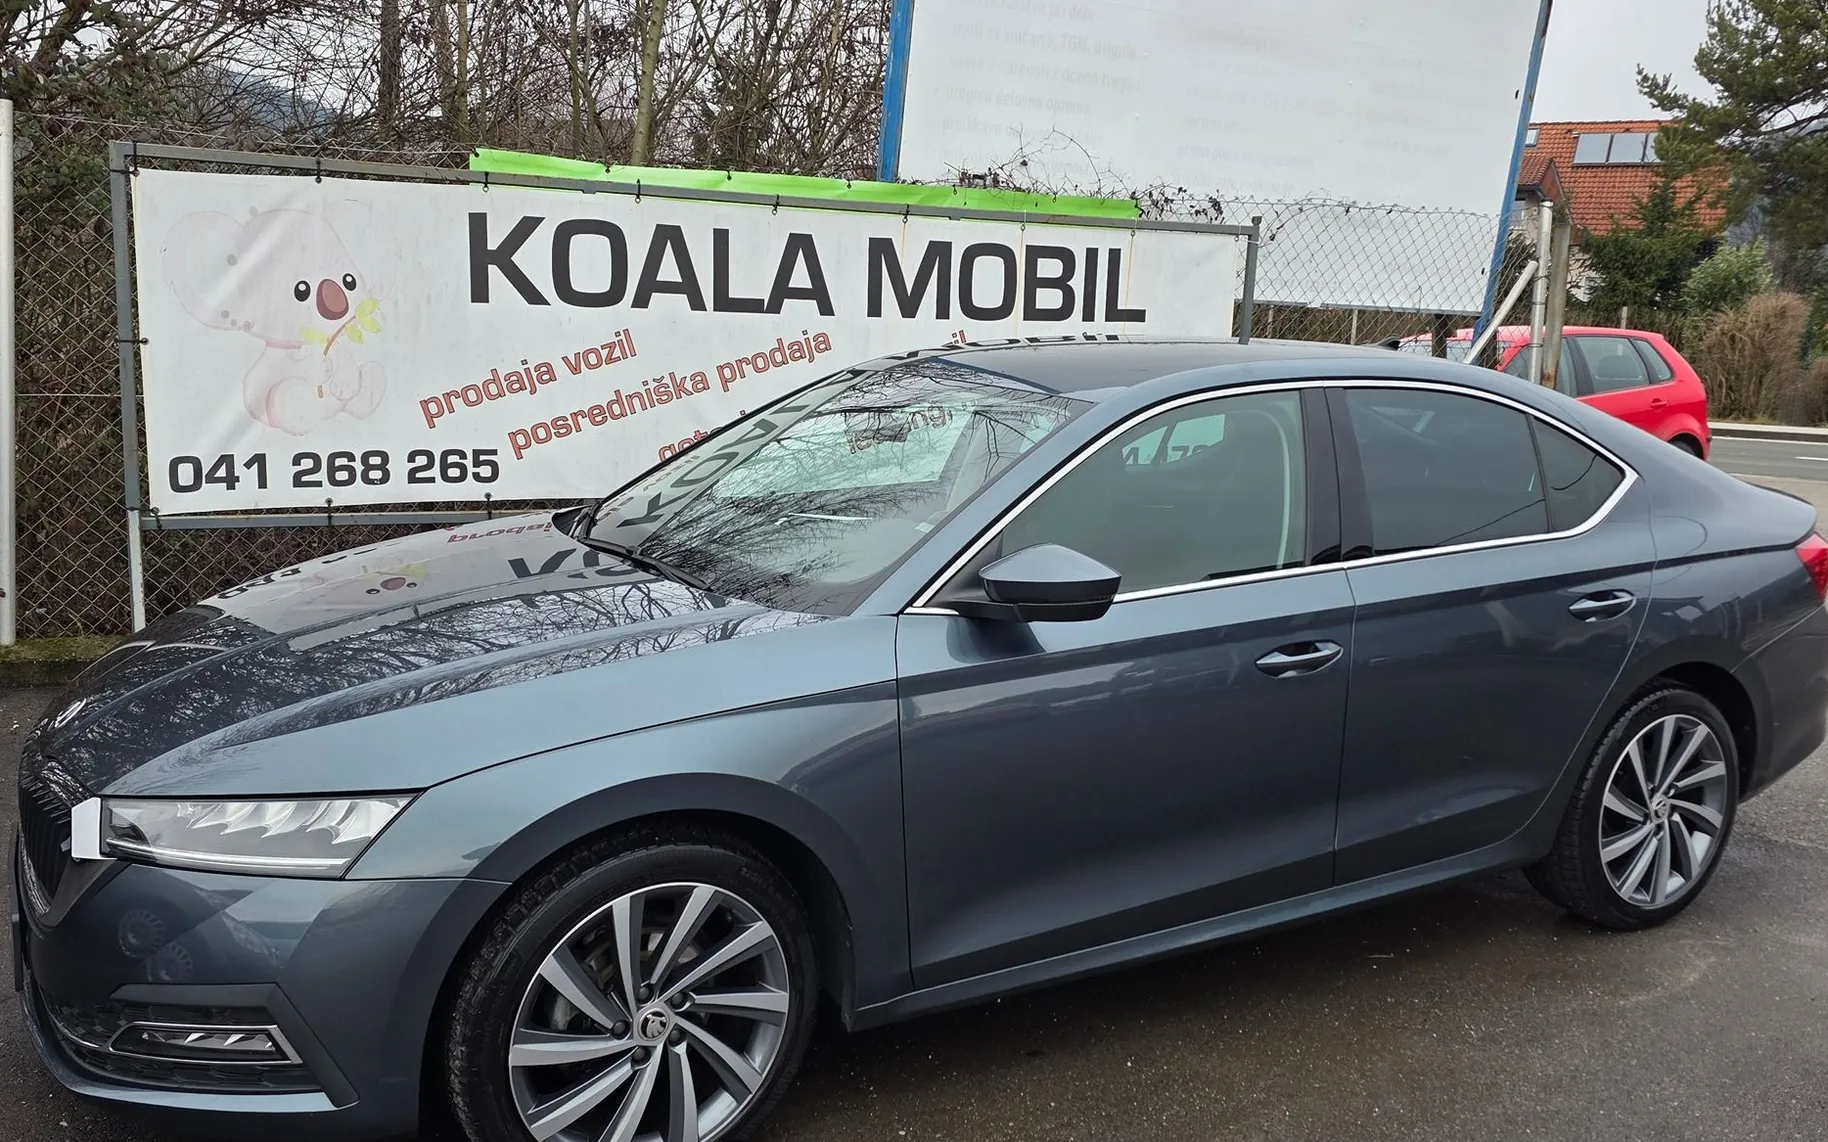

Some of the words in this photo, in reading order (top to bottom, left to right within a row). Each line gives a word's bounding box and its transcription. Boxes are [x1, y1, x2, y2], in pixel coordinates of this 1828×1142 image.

[469, 213, 835, 316] KOALA
[867, 238, 1146, 322] MOBIL
[419, 359, 557, 429] prodaja
[561, 328, 637, 376] vozil
[507, 372, 710, 460] posredniška
[716, 330, 832, 392] prodaja
[169, 453, 267, 493] 041
[292, 450, 390, 487] 268
[408, 449, 499, 484] 265
